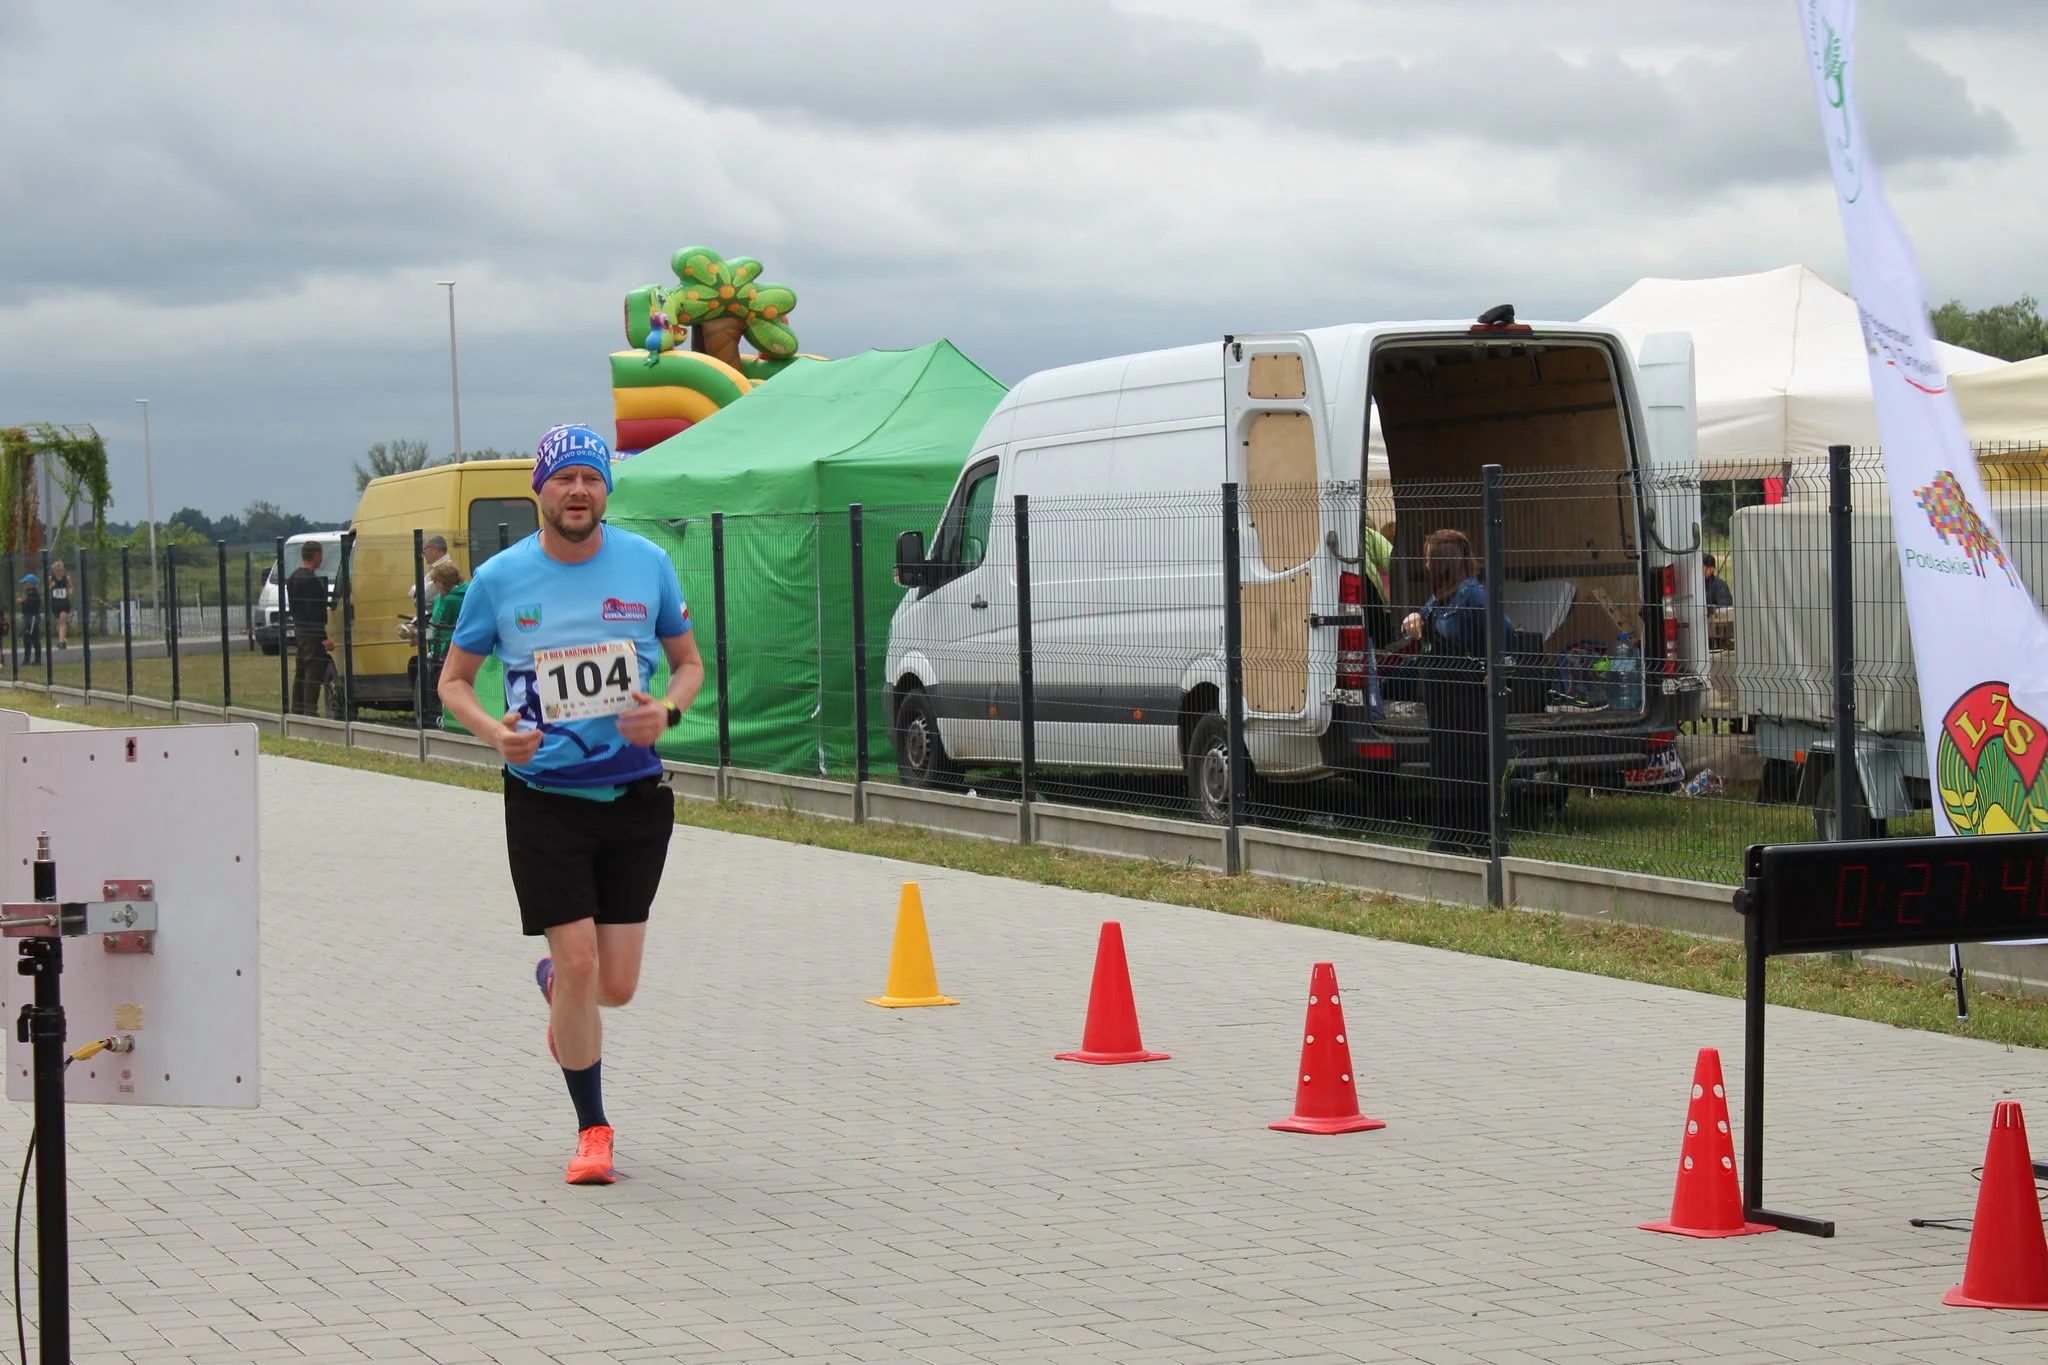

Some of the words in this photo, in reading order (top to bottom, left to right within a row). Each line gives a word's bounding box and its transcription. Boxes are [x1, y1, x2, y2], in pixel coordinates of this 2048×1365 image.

[545, 435, 607, 467] WILKA
[1905, 548, 1972, 576] Podlaskie
[548, 656, 631, 700] 104
